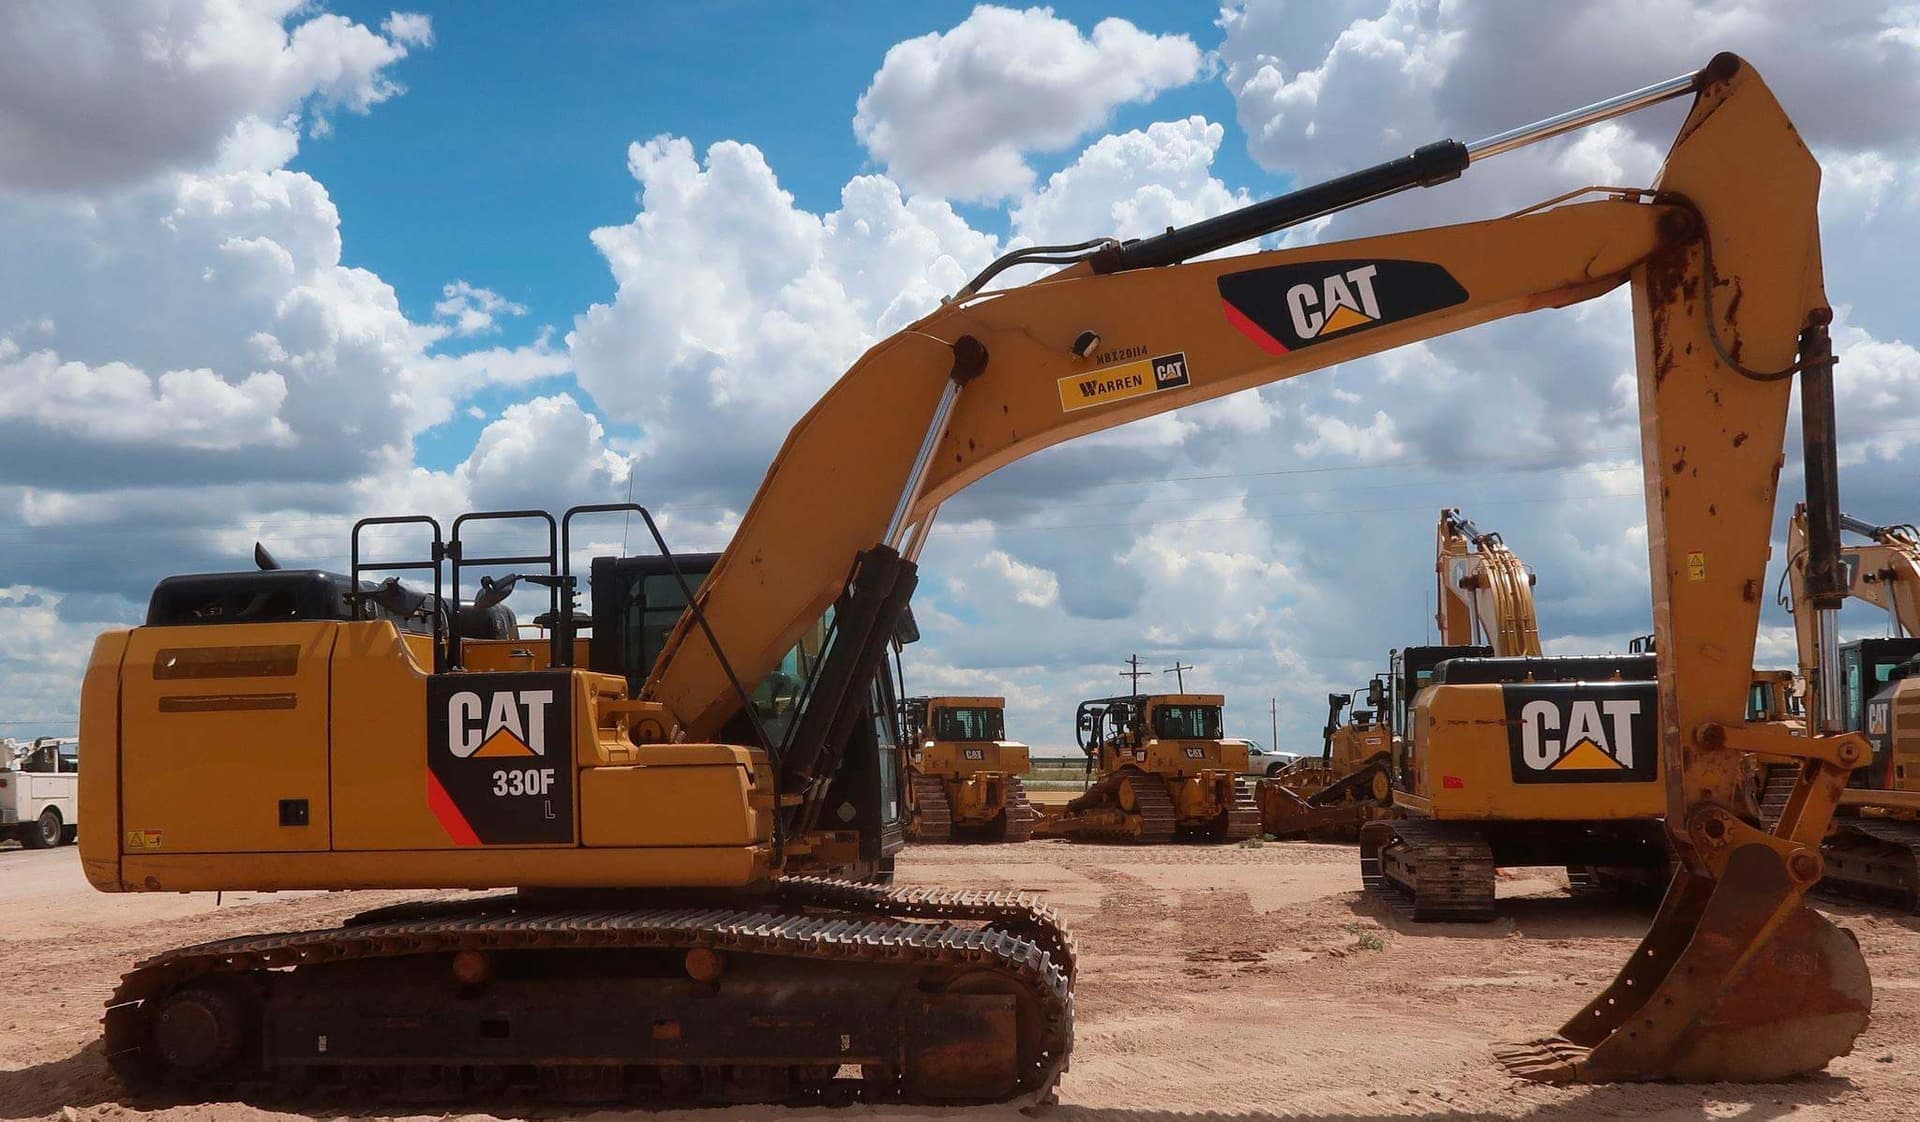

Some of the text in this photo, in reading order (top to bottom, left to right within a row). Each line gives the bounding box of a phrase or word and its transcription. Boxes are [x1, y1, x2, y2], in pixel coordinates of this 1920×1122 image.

[1287, 265, 1381, 339] CAT
[1079, 362, 1183, 397] WARREN CAT
[449, 690, 553, 758] CAT
[1521, 700, 1641, 770] CAT
[1869, 703, 1888, 734] CAT
[492, 769, 555, 796] 330F
[544, 800, 556, 819] L
